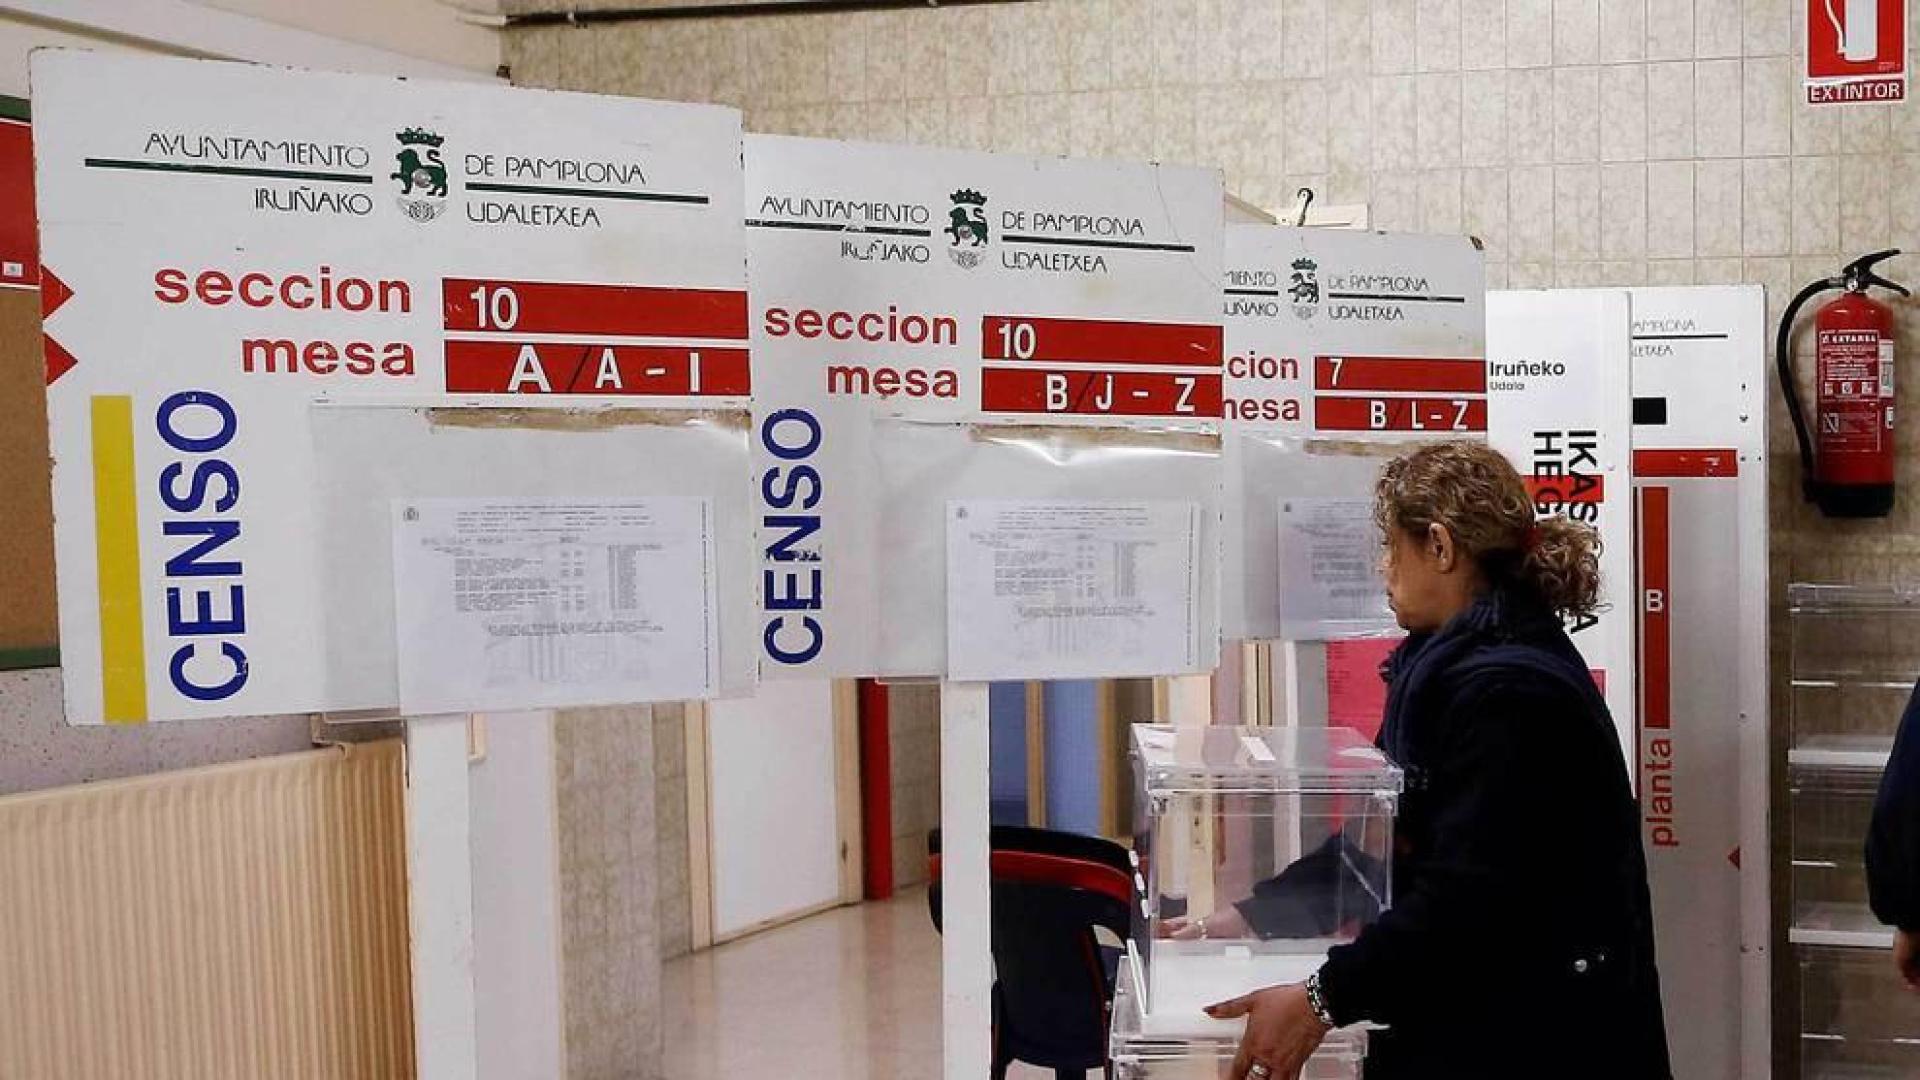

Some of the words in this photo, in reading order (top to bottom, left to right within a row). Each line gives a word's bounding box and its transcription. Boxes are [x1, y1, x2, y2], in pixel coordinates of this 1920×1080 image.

[1811, 83, 1900, 100] EXTINTOR
[144, 133, 369, 168] AYUNTAMIENTO
[465, 155, 494, 176] DE
[505, 157, 646, 185] PAMPLONA
[255, 186, 372, 214] IRUÑAKO
[467, 202, 601, 227] UDALETXEA
[760, 196, 930, 224] AYUNTAMIENTO
[1002, 211, 1026, 230] DE
[1034, 215, 1144, 236] PAMPLONA
[1002, 250, 1107, 274] UDALETXEA
[154, 266, 412, 313] seccion
[470, 286, 519, 330] 10
[1328, 305, 1405, 321] UDALETXEA
[764, 306, 958, 344] seccion
[999, 323, 1036, 360] 10
[241, 338, 416, 376] mesa
[1227, 350, 1299, 380] cion
[1329, 358, 1343, 387] 7
[1490, 360, 1566, 377] Iruñeko
[827, 365, 959, 398] mesa
[1490, 381, 1525, 391] Udala
[156, 389, 249, 701] CENSO
[761, 407, 823, 665] CENSO
[1645, 589, 1663, 612] B
[1645, 738, 1679, 848] planta
